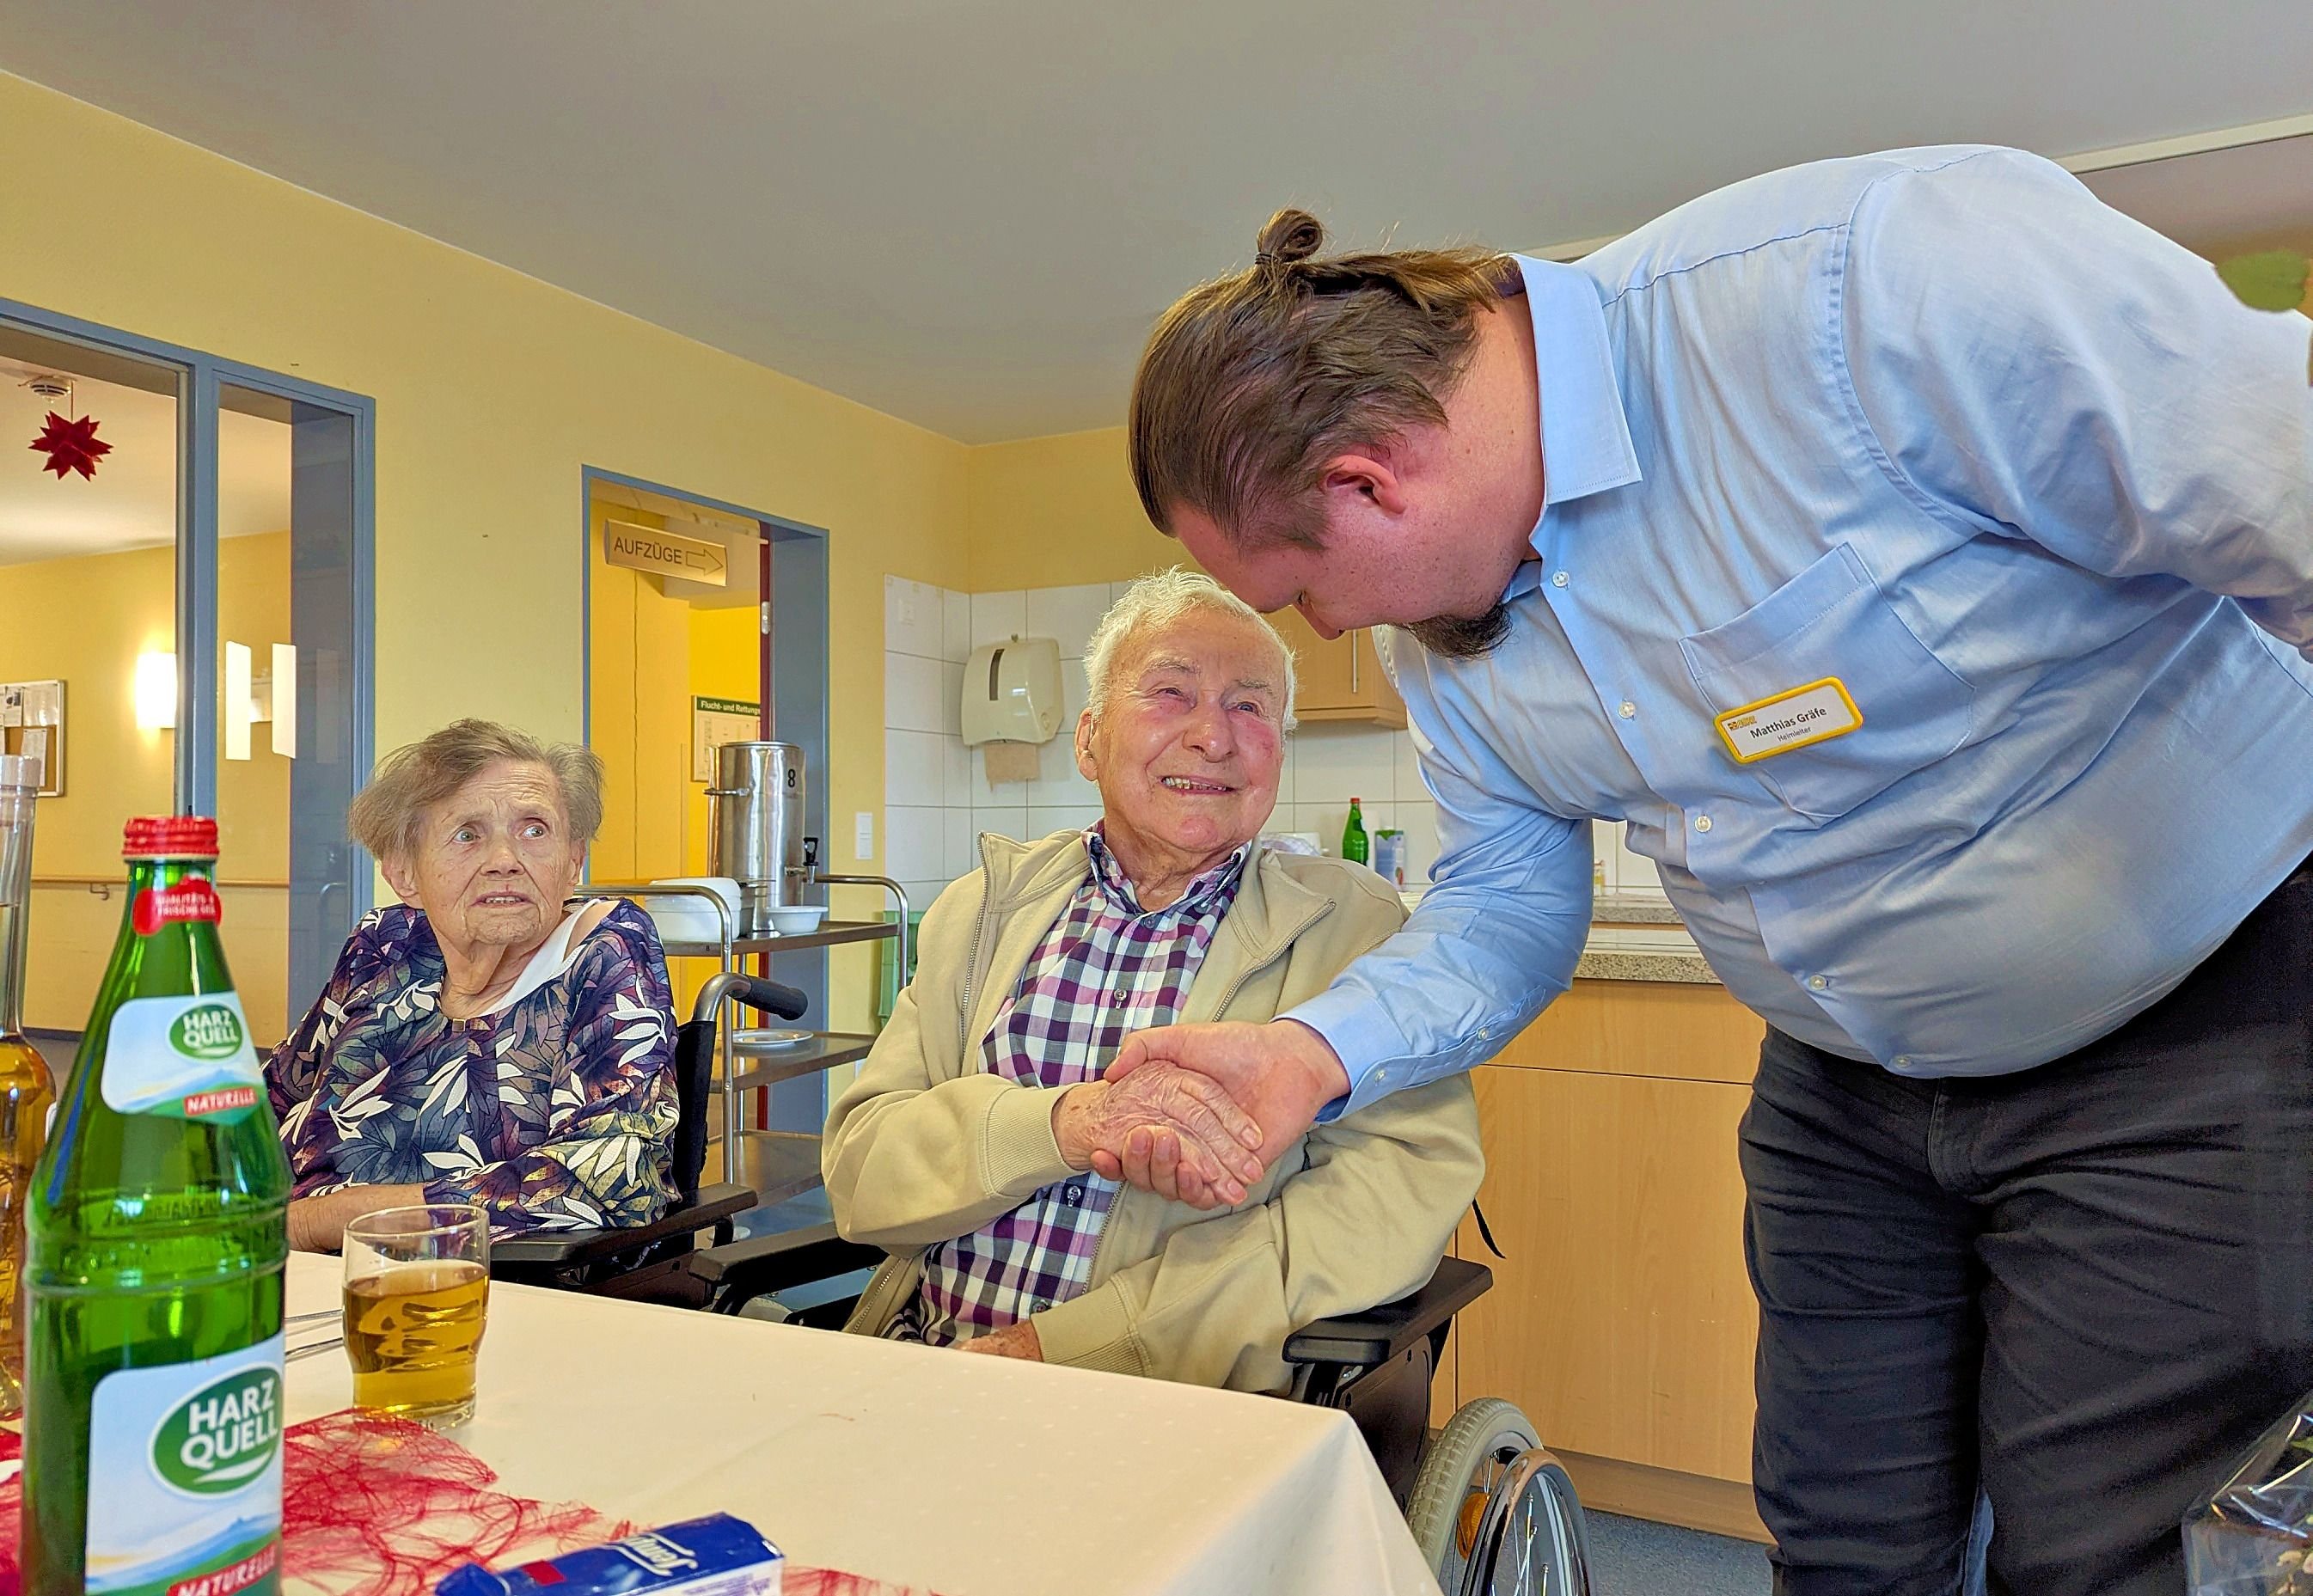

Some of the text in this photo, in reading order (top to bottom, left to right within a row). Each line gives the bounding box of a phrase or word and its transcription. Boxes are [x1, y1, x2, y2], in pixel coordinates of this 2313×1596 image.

[614, 535, 682, 565] AUFZÜGE
[701, 700, 723, 712] Flucht-
[723, 703, 736, 712] und
[1750, 719, 1796, 739] Matthias
[1796, 707, 1827, 724] Gräfe
[1777, 726, 1811, 742] Heimleiter
[787, 768, 796, 788] 8
[183, 1010, 233, 1031] HARZ
[183, 1023, 240, 1049] QUELL
[187, 1088, 256, 1115] NATURELLE
[188, 1377, 275, 1435] HARZ
[180, 1409, 278, 1470] QUELL
